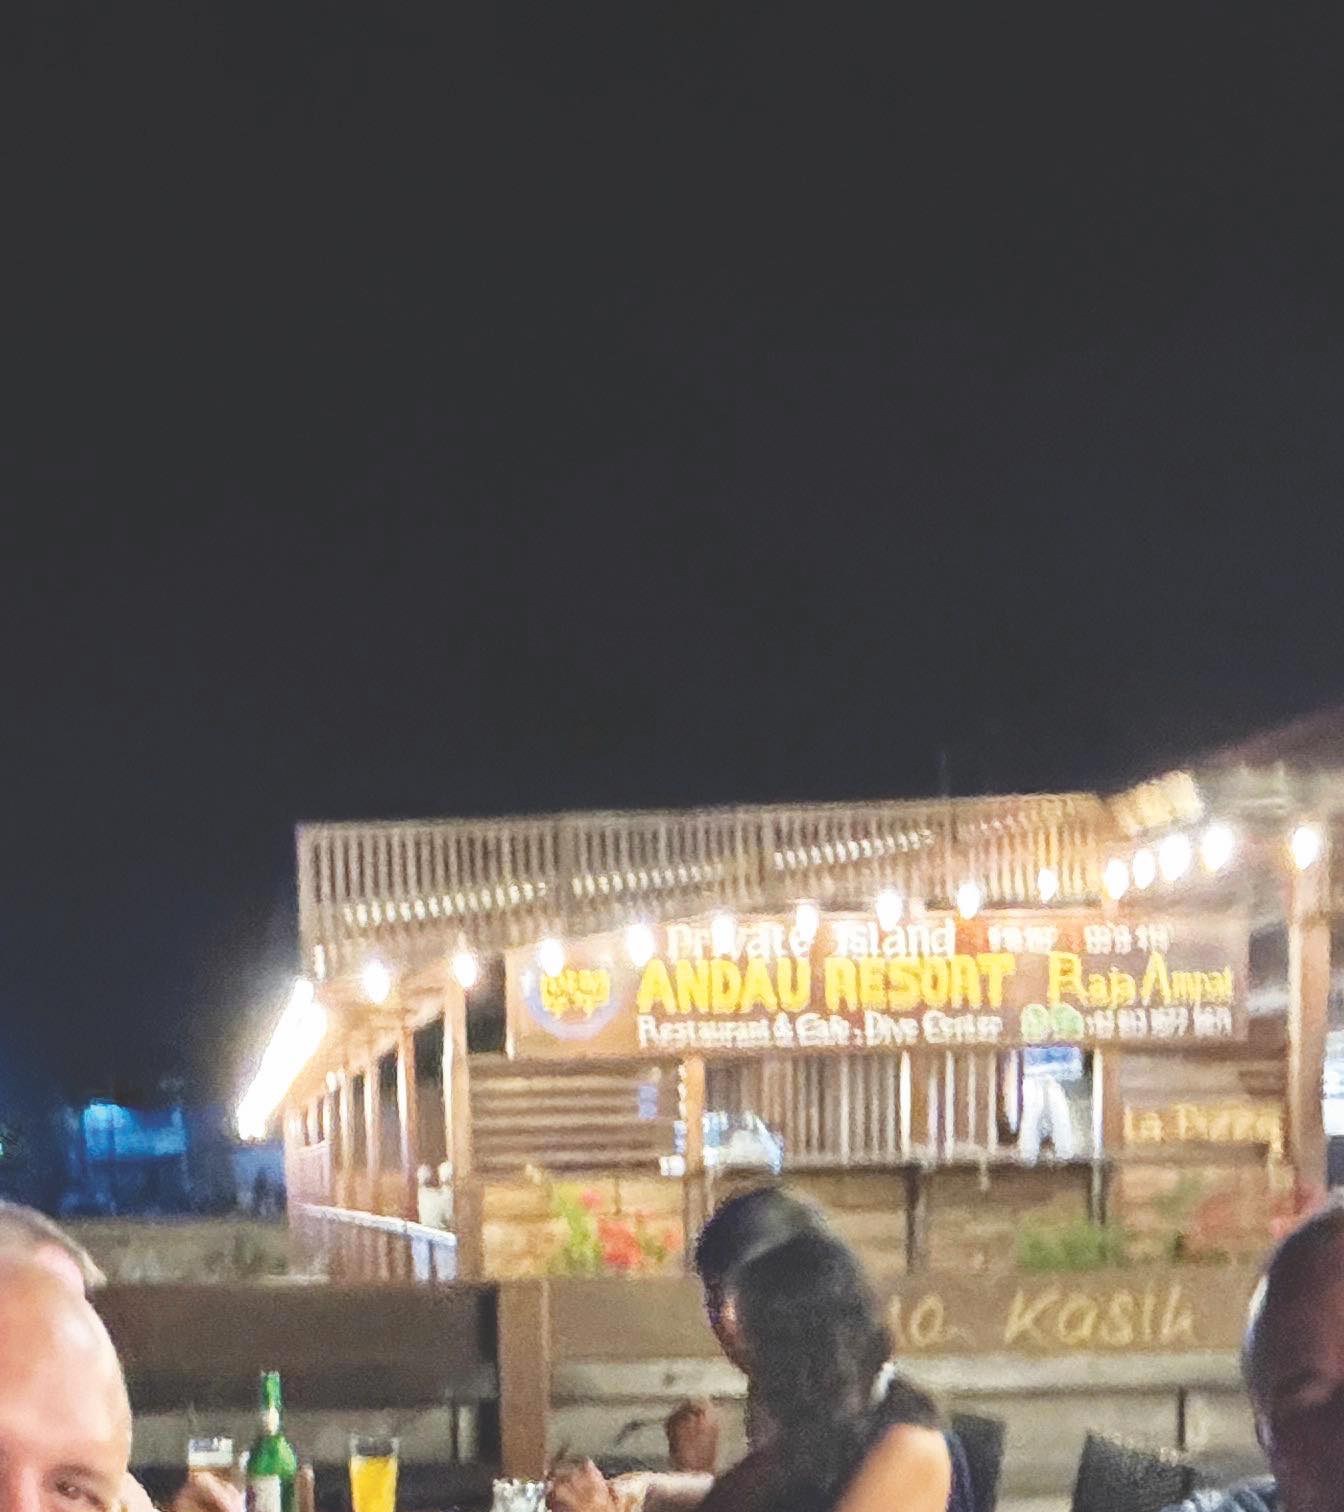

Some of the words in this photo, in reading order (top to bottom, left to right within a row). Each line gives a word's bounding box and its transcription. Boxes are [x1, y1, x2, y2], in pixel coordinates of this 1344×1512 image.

[667, 922, 818, 964] Prvate
[636, 956, 812, 1015] ANDAU
[824, 953, 1016, 1010] RESORT
